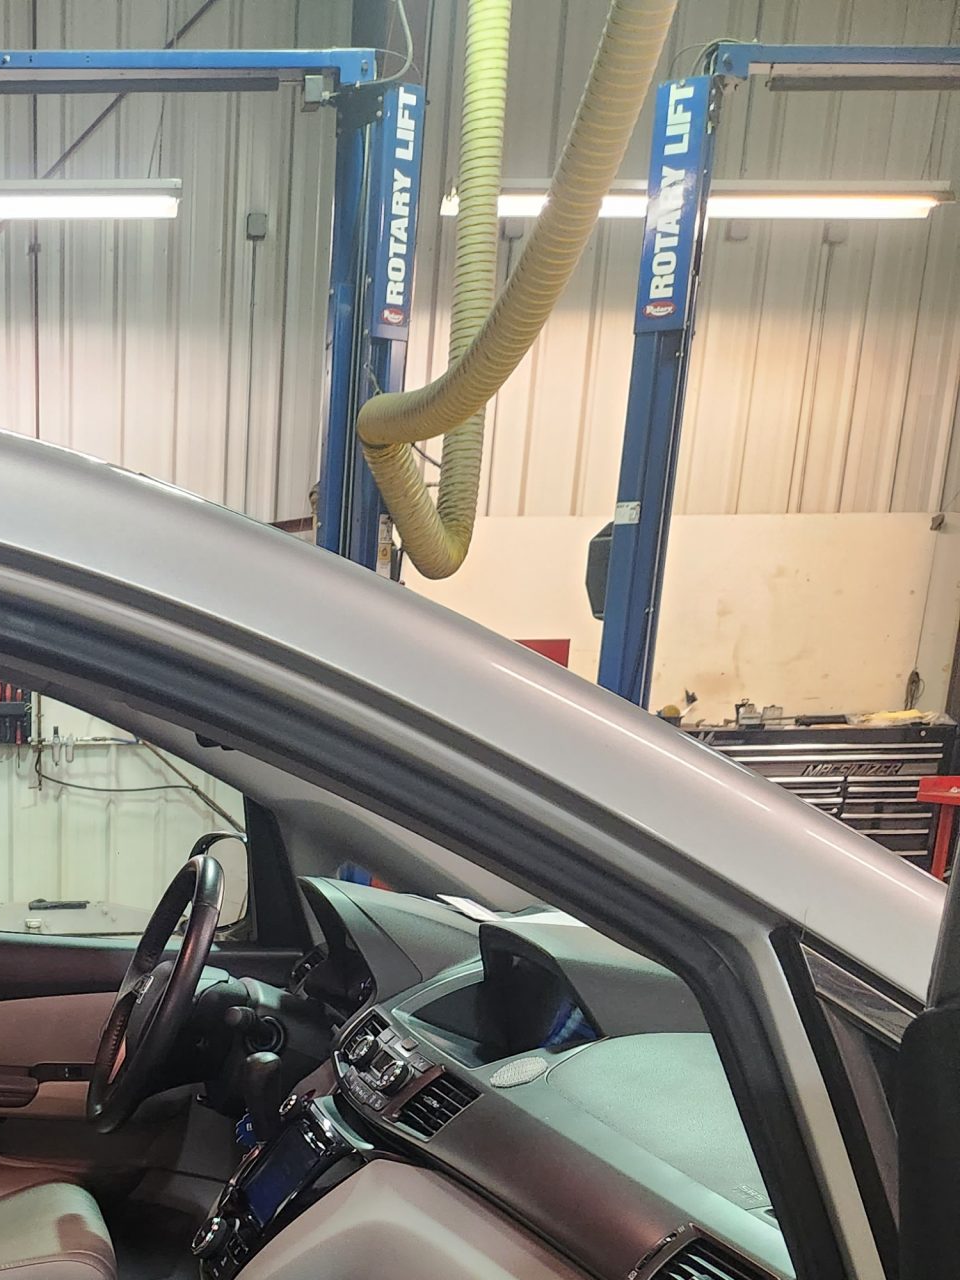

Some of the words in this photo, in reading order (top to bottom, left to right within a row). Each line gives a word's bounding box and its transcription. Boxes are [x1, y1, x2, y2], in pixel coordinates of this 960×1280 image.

[395, 87, 417, 160] LIFT
[664, 84, 695, 156] LIFT
[386, 168, 412, 306] ROTARY
[650, 166, 686, 299] ROTARY
